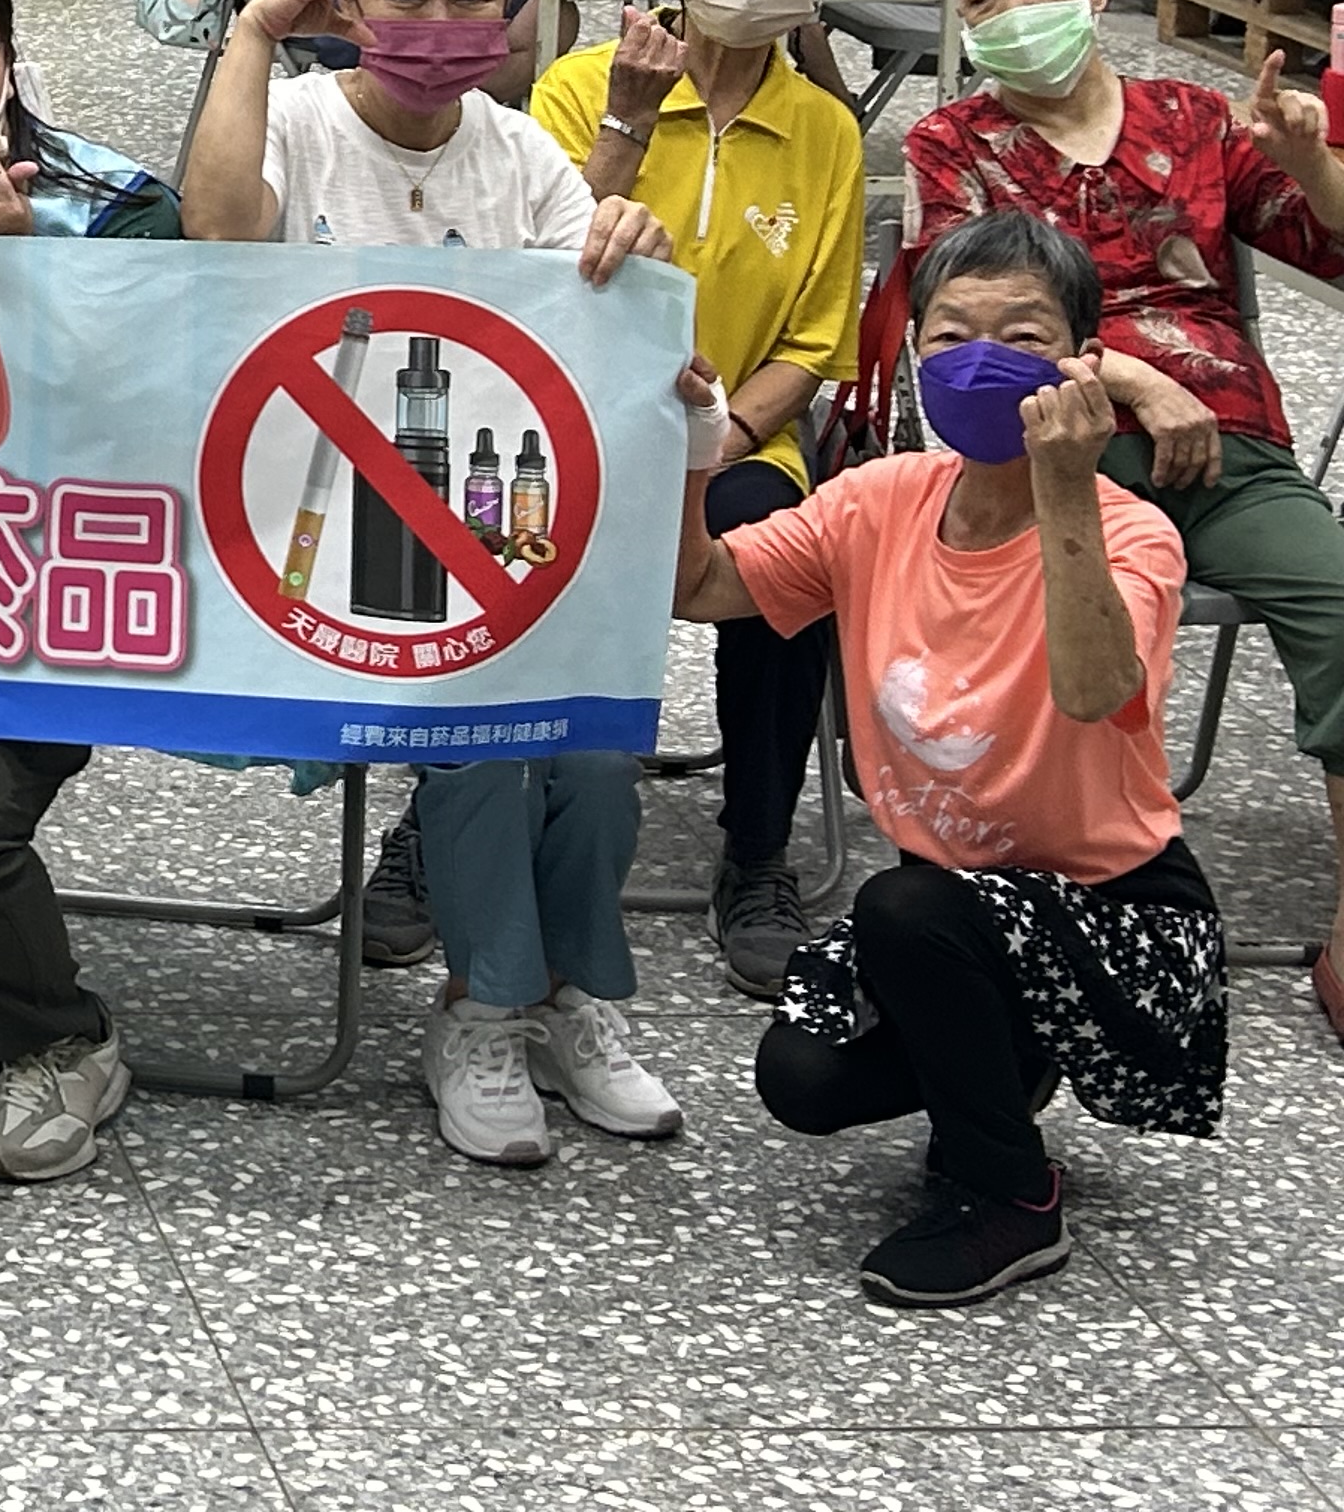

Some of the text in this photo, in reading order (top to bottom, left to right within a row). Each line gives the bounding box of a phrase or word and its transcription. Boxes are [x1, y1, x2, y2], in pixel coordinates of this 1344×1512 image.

[280, 606, 497, 670] 天晟醫院 關心您
